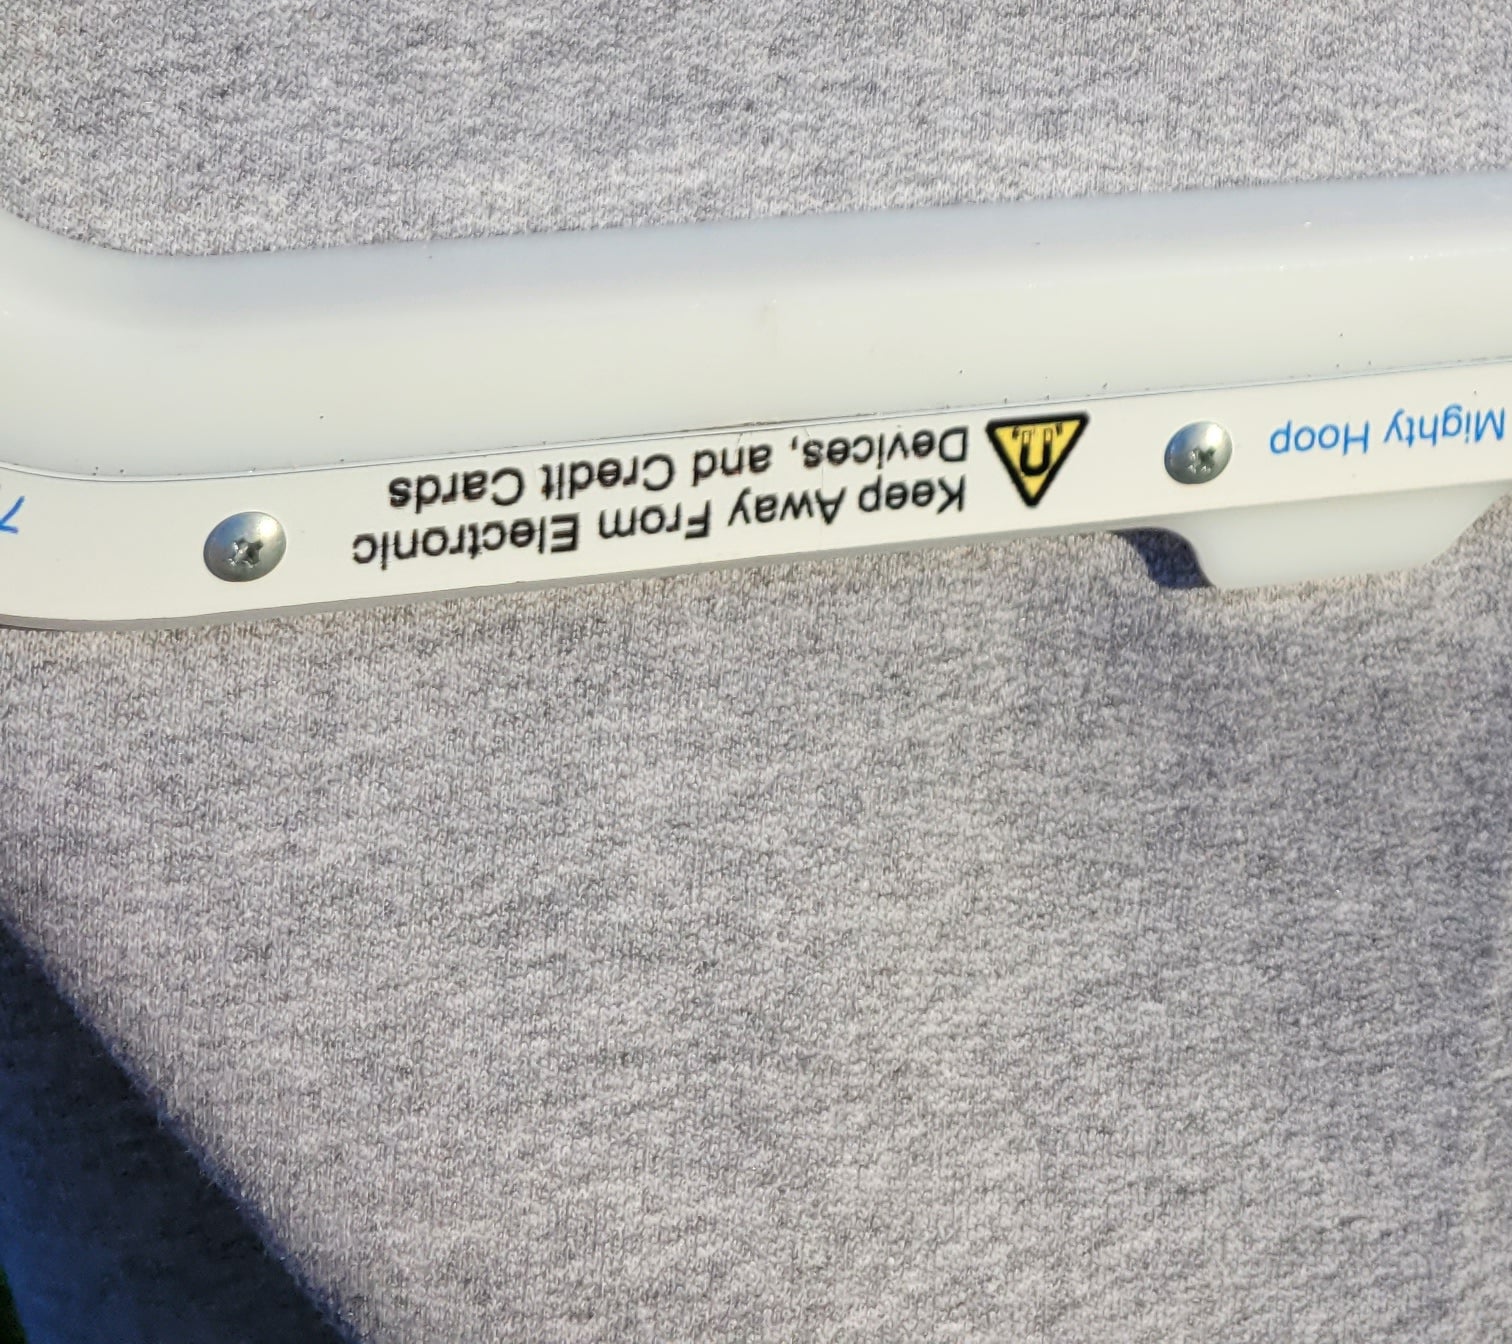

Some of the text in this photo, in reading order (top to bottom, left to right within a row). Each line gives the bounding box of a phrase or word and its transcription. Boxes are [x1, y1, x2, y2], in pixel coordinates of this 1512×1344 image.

[1269, 420, 1370, 456] Hoop
[1383, 403, 1506, 448] Mighty
[388, 425, 970, 513] Devices, and Credit Cards
[352, 474, 967, 571] Keep Away From Electronic
